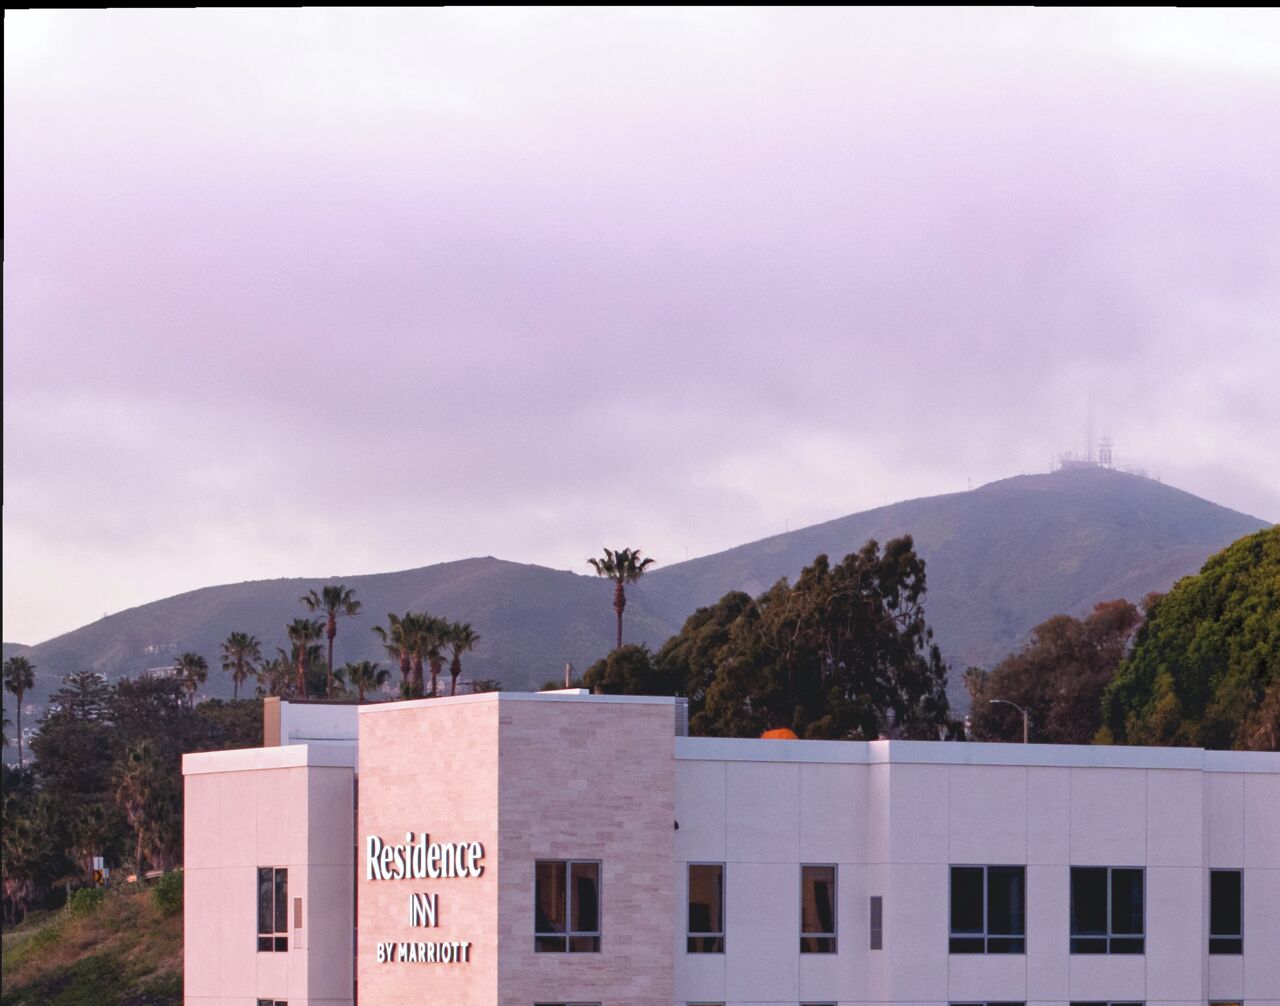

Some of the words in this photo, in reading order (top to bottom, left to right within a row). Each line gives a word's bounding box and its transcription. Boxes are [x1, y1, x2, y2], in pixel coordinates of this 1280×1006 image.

[366, 831, 485, 880] Residence
[377, 942, 396, 963] BY
[398, 941, 471, 963] MARRIOTT
